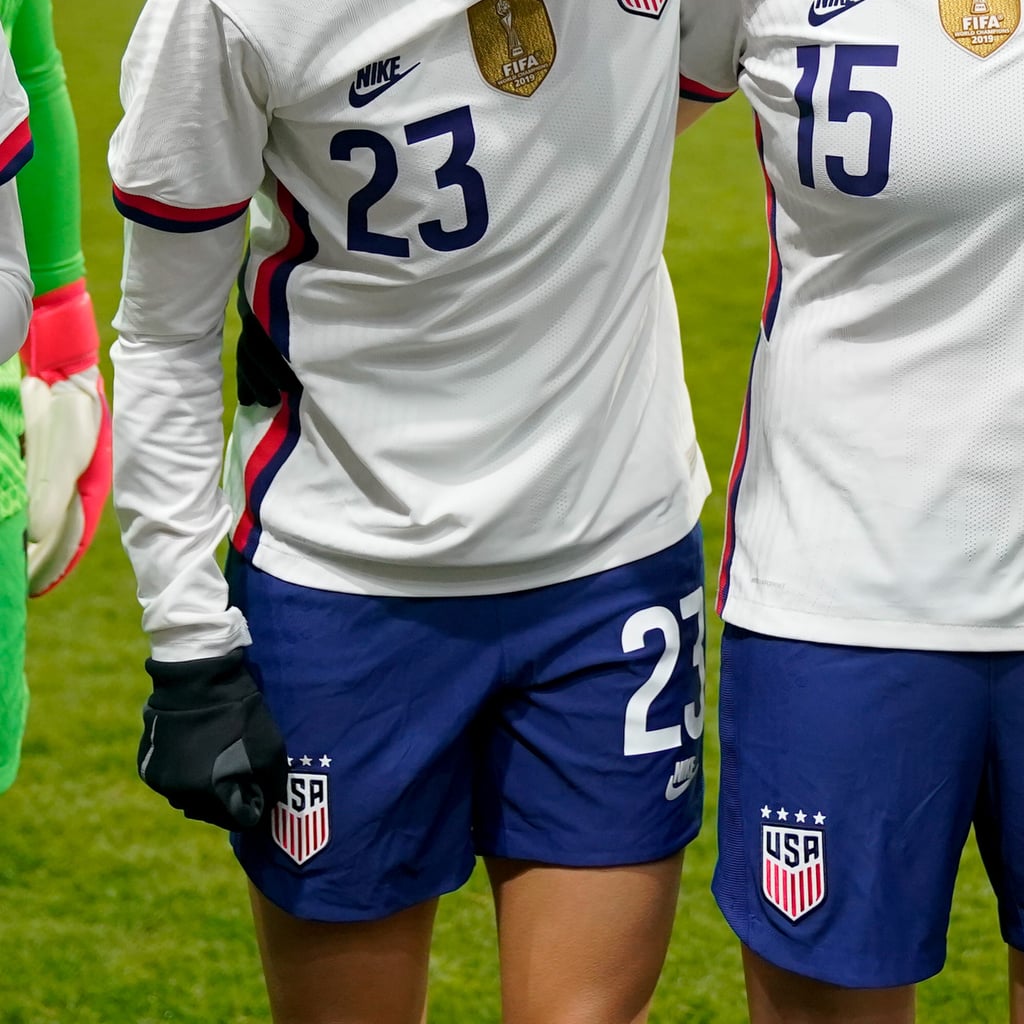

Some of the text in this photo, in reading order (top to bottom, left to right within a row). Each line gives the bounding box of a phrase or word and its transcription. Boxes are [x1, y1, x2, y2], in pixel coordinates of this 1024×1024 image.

[962, 15, 1001, 31] FIFA
[972, 34, 994, 45] 2019
[355, 55, 401, 90] NIKE
[503, 55, 539, 77] FIFA
[513, 73, 536, 88] 2019
[793, 44, 900, 198] 15
[329, 104, 490, 259] 23
[620, 585, 706, 757] 23
[288, 778, 324, 812] SA
[766, 831, 820, 868] USA
